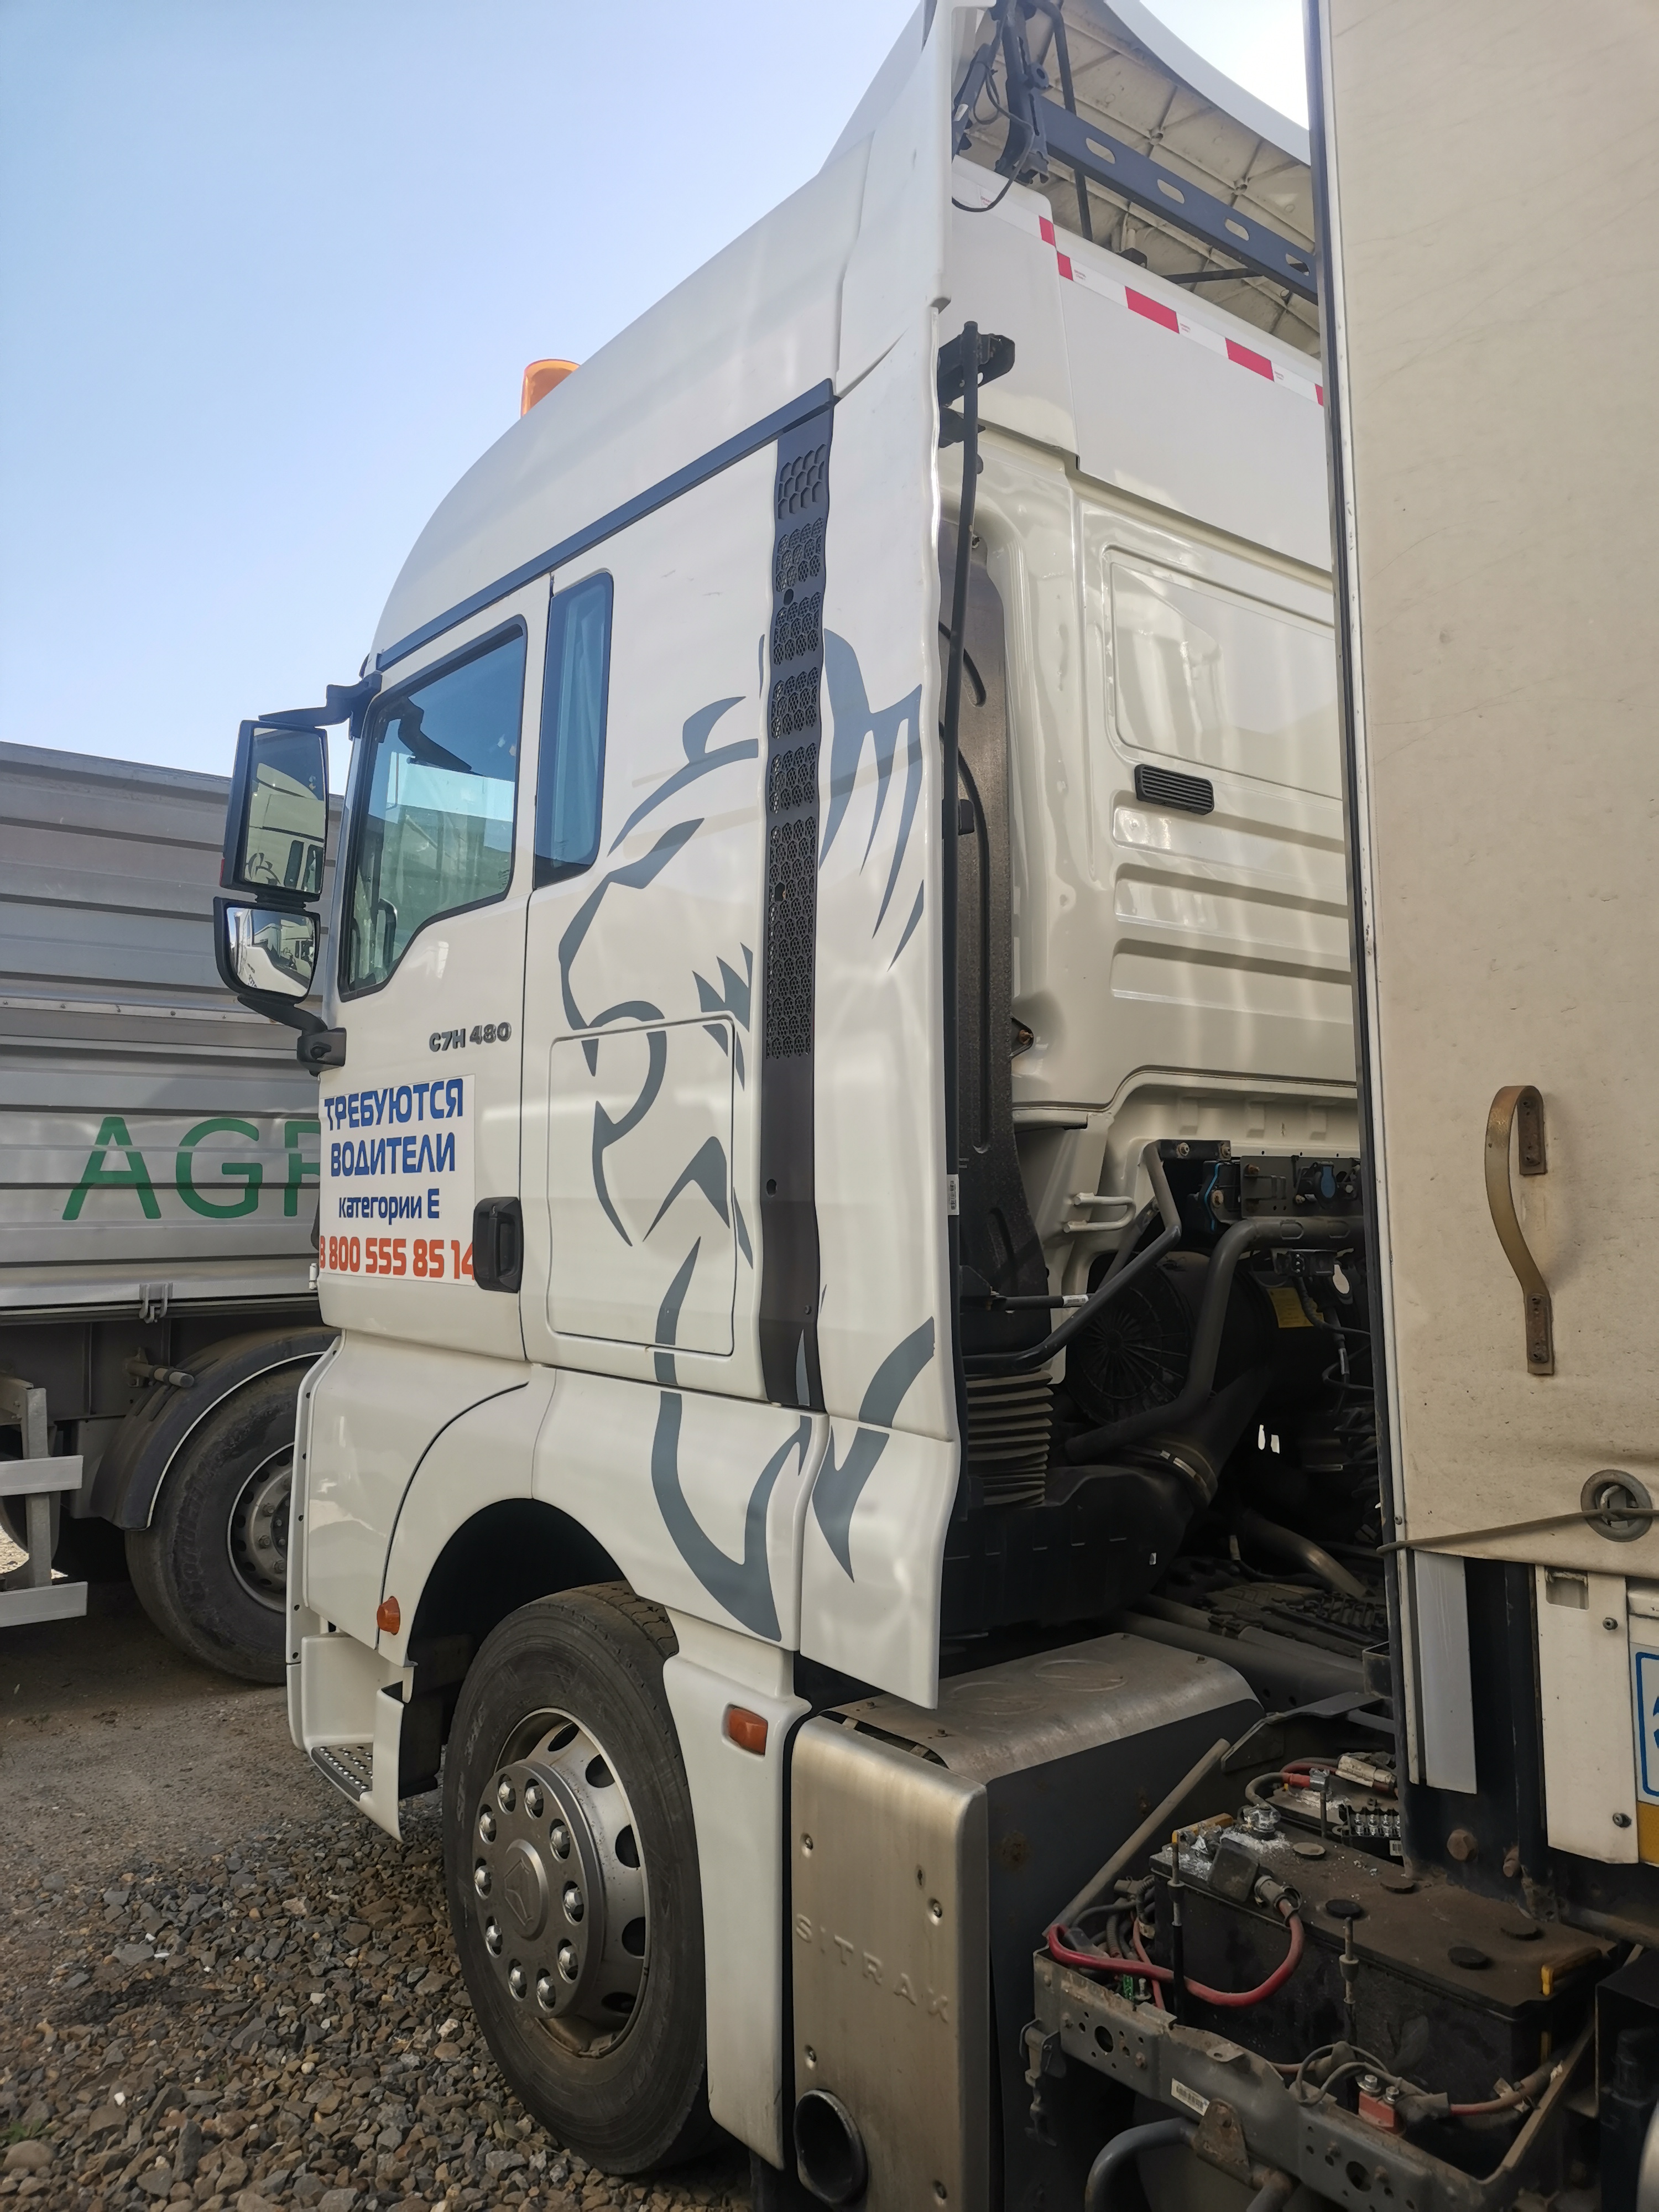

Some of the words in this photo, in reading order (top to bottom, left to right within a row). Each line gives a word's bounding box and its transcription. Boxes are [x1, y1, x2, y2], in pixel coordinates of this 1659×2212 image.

[429, 1028, 466, 1052] C7H
[469, 1022, 512, 1045] 480
[324, 1078, 463, 1130] ТРЕБУЮТСЯ
[331, 1132, 455, 1177] ВОДИТЕЛИ
[338, 1195, 422, 1225] категории
[427, 1188, 439, 1218] Е
[329, 1236, 360, 1272] 800
[366, 1238, 406, 1275] 555
[413, 1239, 444, 1277] 85
